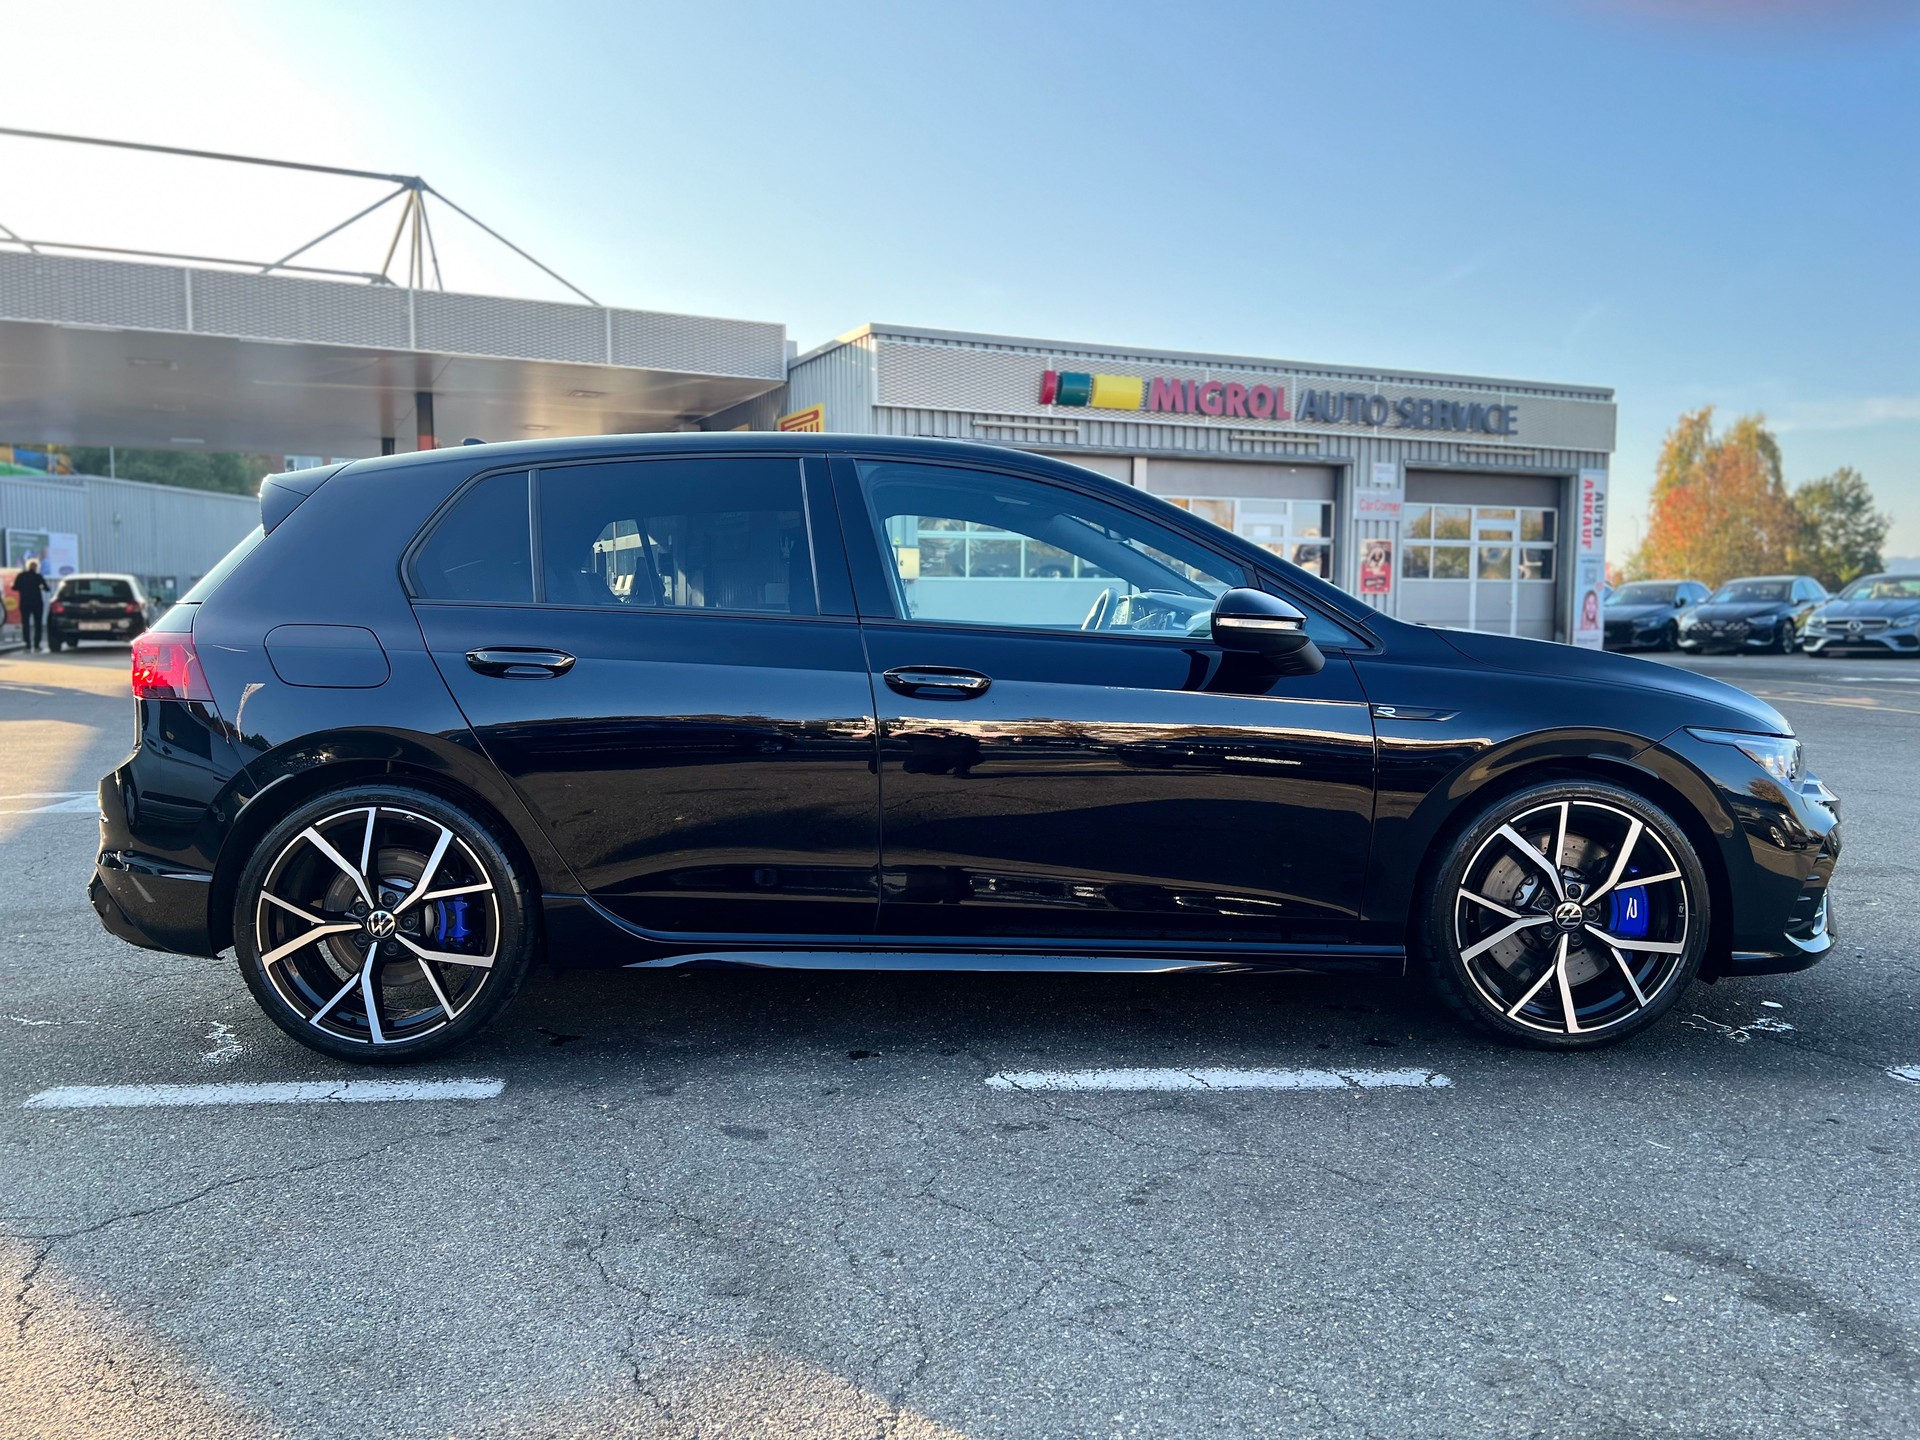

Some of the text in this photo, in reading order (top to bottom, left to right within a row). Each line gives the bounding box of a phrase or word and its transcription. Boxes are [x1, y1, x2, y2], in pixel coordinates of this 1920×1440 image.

[1150, 377, 1519, 436] MIGROL AUTO SERVICE
[1581, 479, 1595, 550] ANKAUF
[1593, 491, 1605, 538] AUTO
